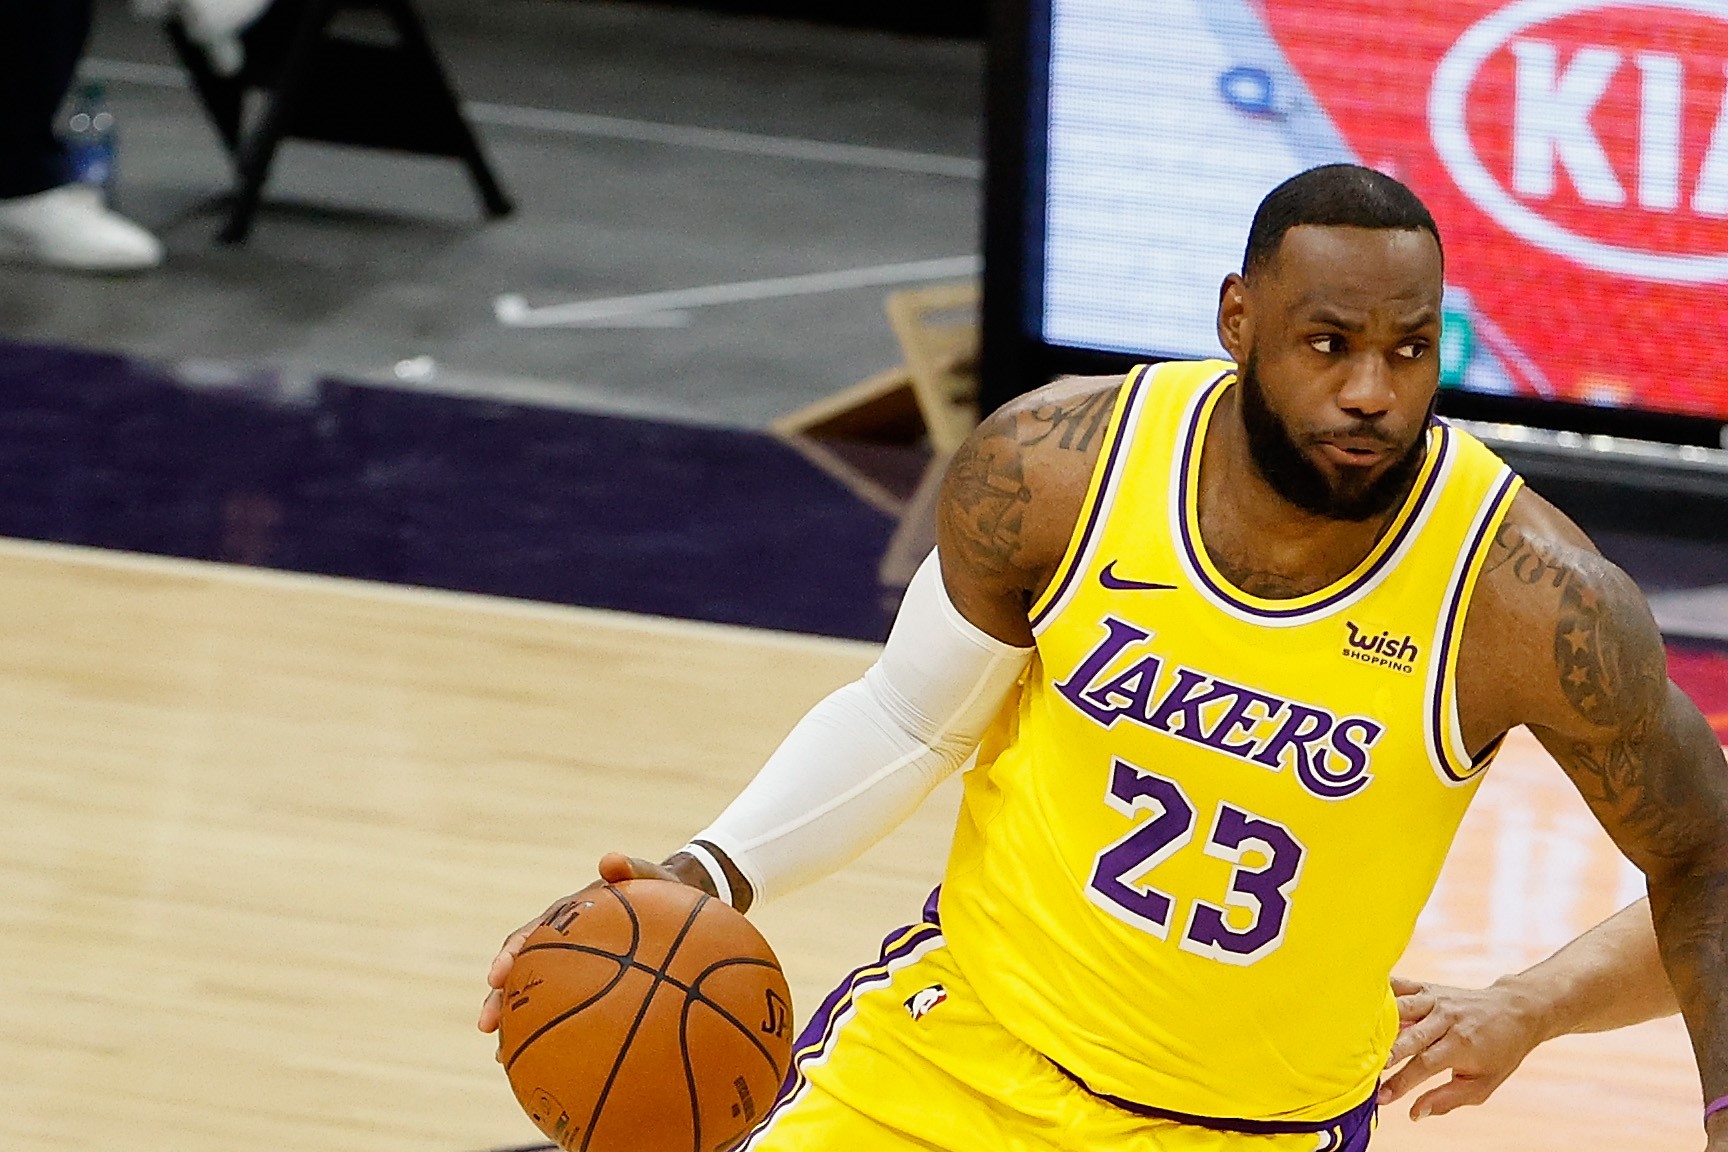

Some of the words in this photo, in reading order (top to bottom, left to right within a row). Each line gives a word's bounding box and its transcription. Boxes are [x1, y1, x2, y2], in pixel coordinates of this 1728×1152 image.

[1342, 648, 1413, 674] SHOPPING
[1345, 620, 1418, 663] wish
[1054, 612, 1388, 801] LAKERS
[1085, 755, 1308, 967] 23
